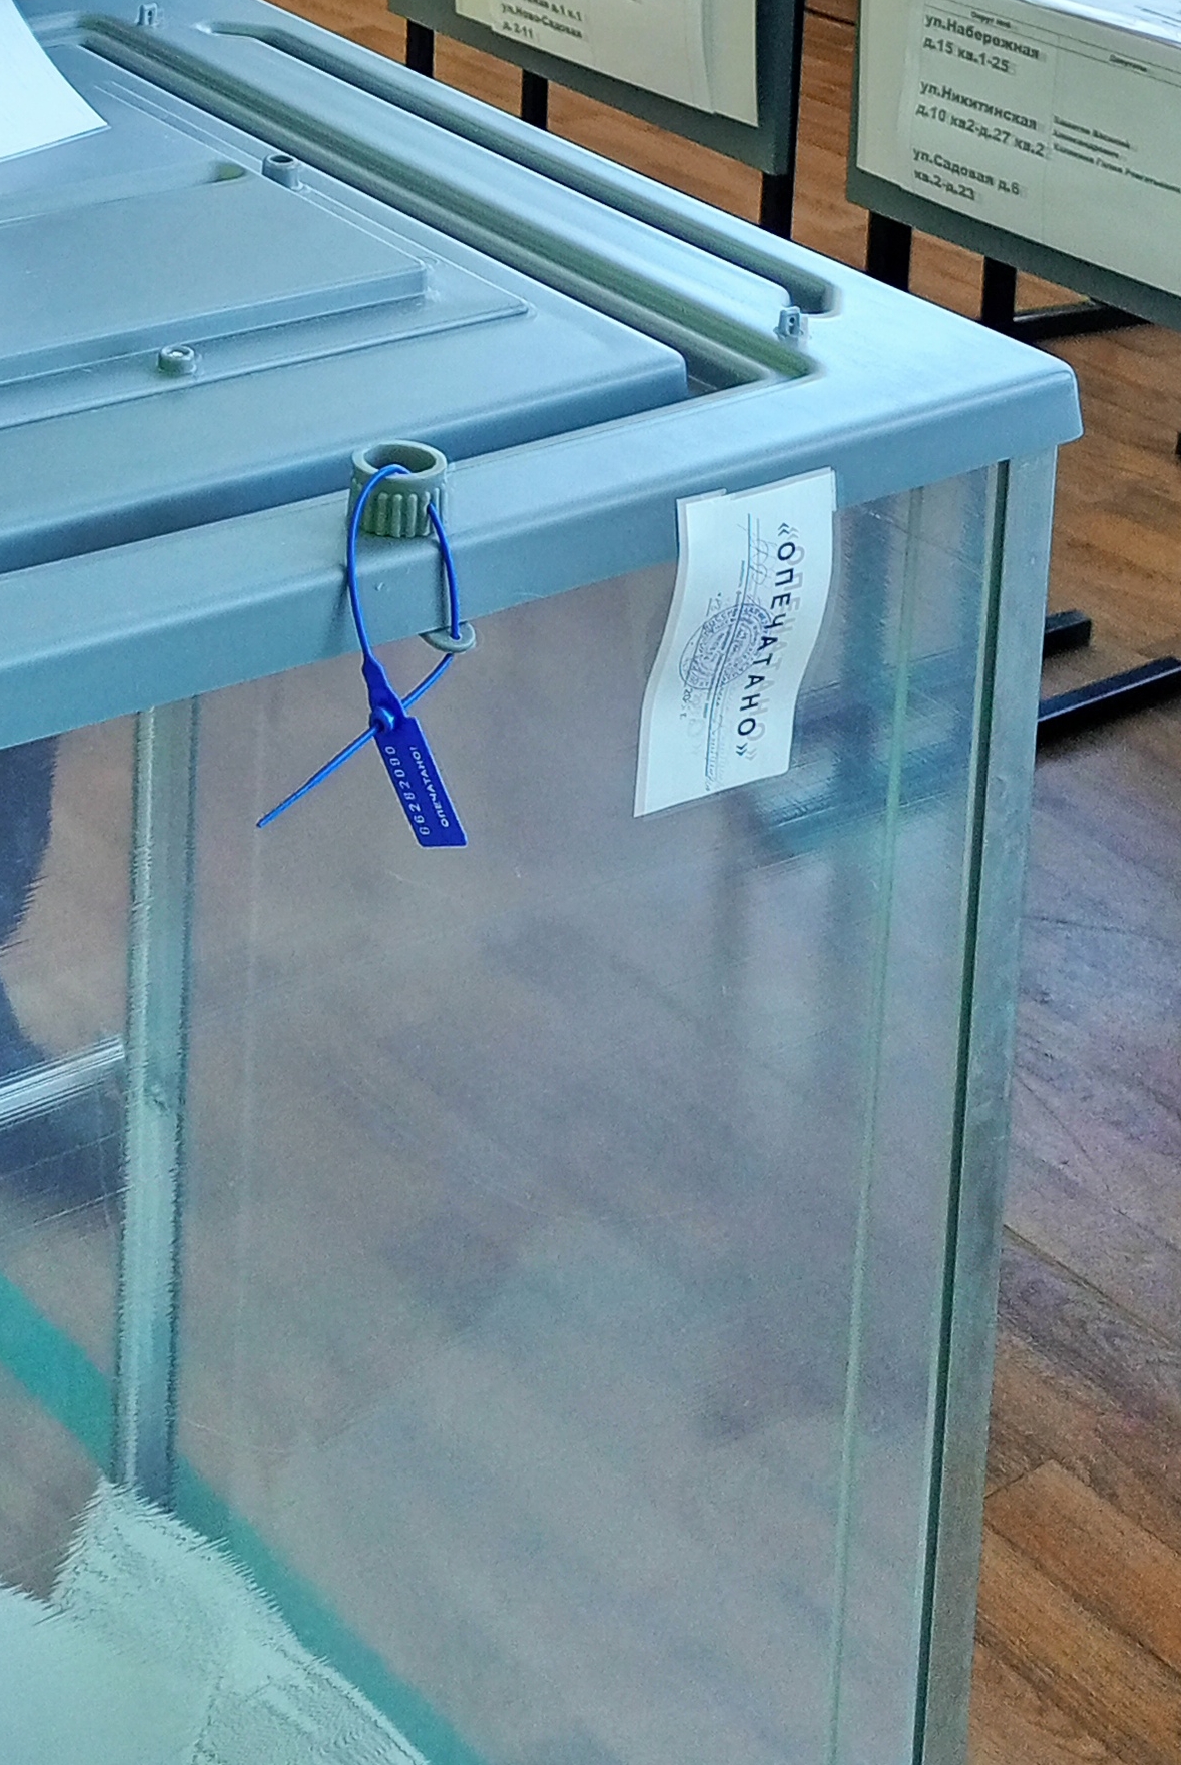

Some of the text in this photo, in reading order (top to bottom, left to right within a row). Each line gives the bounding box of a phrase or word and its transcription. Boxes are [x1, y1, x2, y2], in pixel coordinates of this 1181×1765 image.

[923, 37, 1009, 73] д.15 кв.1-25
[920, 81, 1037, 130] ул.Никитинская
[916, 104, 946, 122] д.10
[1014, 138, 1045, 157] кв.2
[913, 148, 994, 186] ул.Садовая
[735, 521, 797, 758] «ОПЕЧАТАНО»
